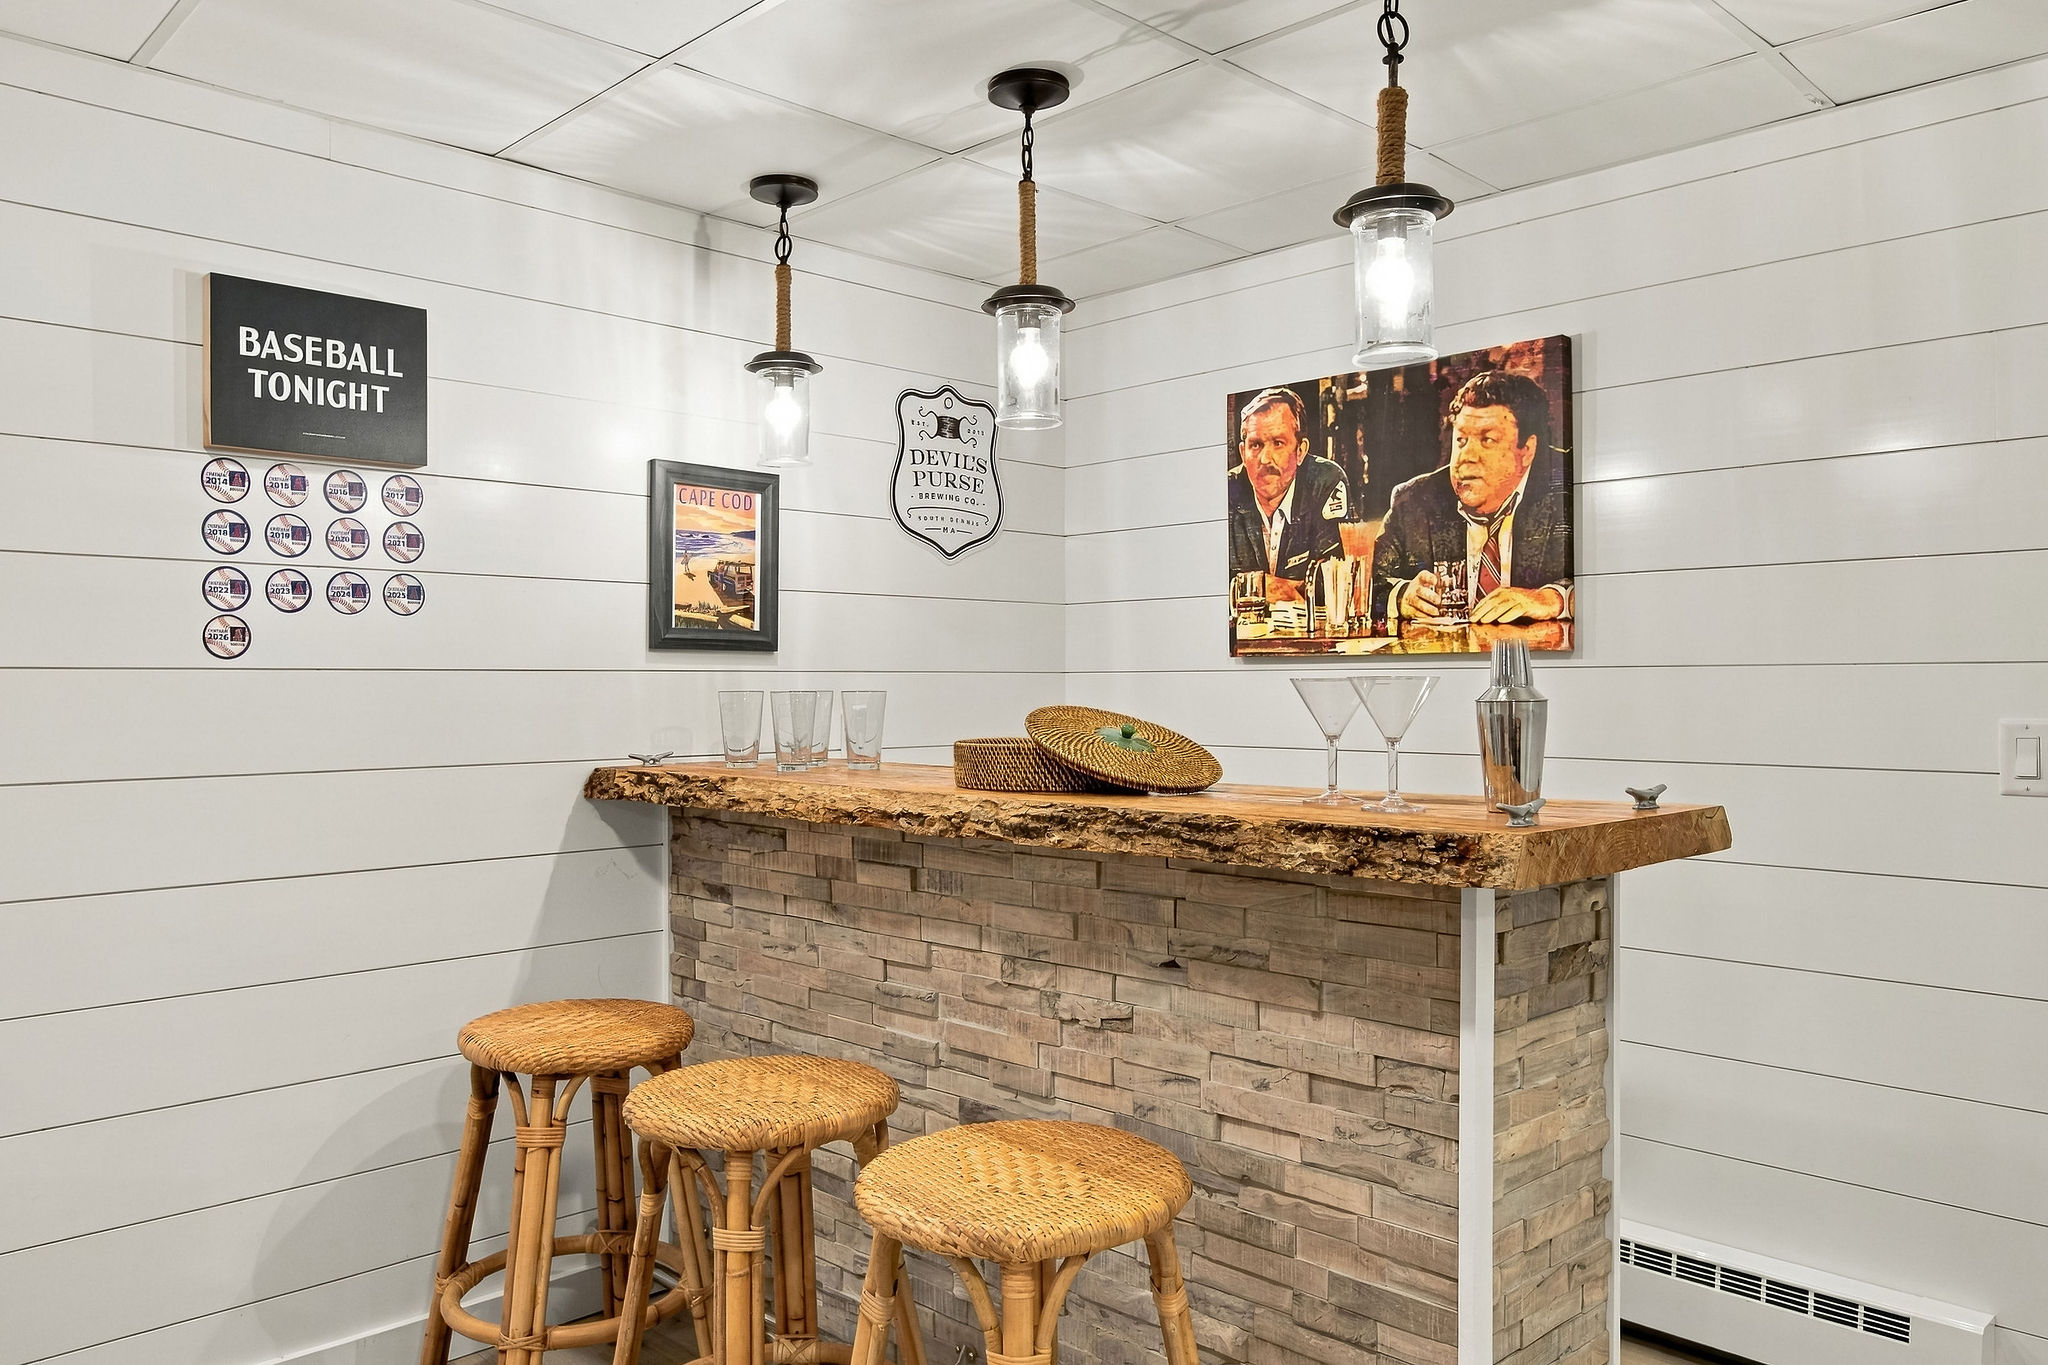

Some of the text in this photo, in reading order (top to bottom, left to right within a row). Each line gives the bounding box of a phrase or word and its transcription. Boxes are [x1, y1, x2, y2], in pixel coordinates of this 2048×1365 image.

[239, 325, 404, 378] BASEBALL
[247, 368, 390, 414] TONIGHT
[909, 448, 988, 475] DEVIL'S
[205, 477, 228, 486] 2014
[912, 470, 985, 494] PURSE
[679, 488, 753, 511] CAPE COD
[918, 492, 979, 506] BREWING CO.
[950, 517, 979, 527] DENNIS
[270, 531, 290, 539] 2019
[387, 539, 405, 547] 2021
[208, 586, 229, 594] 2022
[208, 633, 229, 641] 2026
